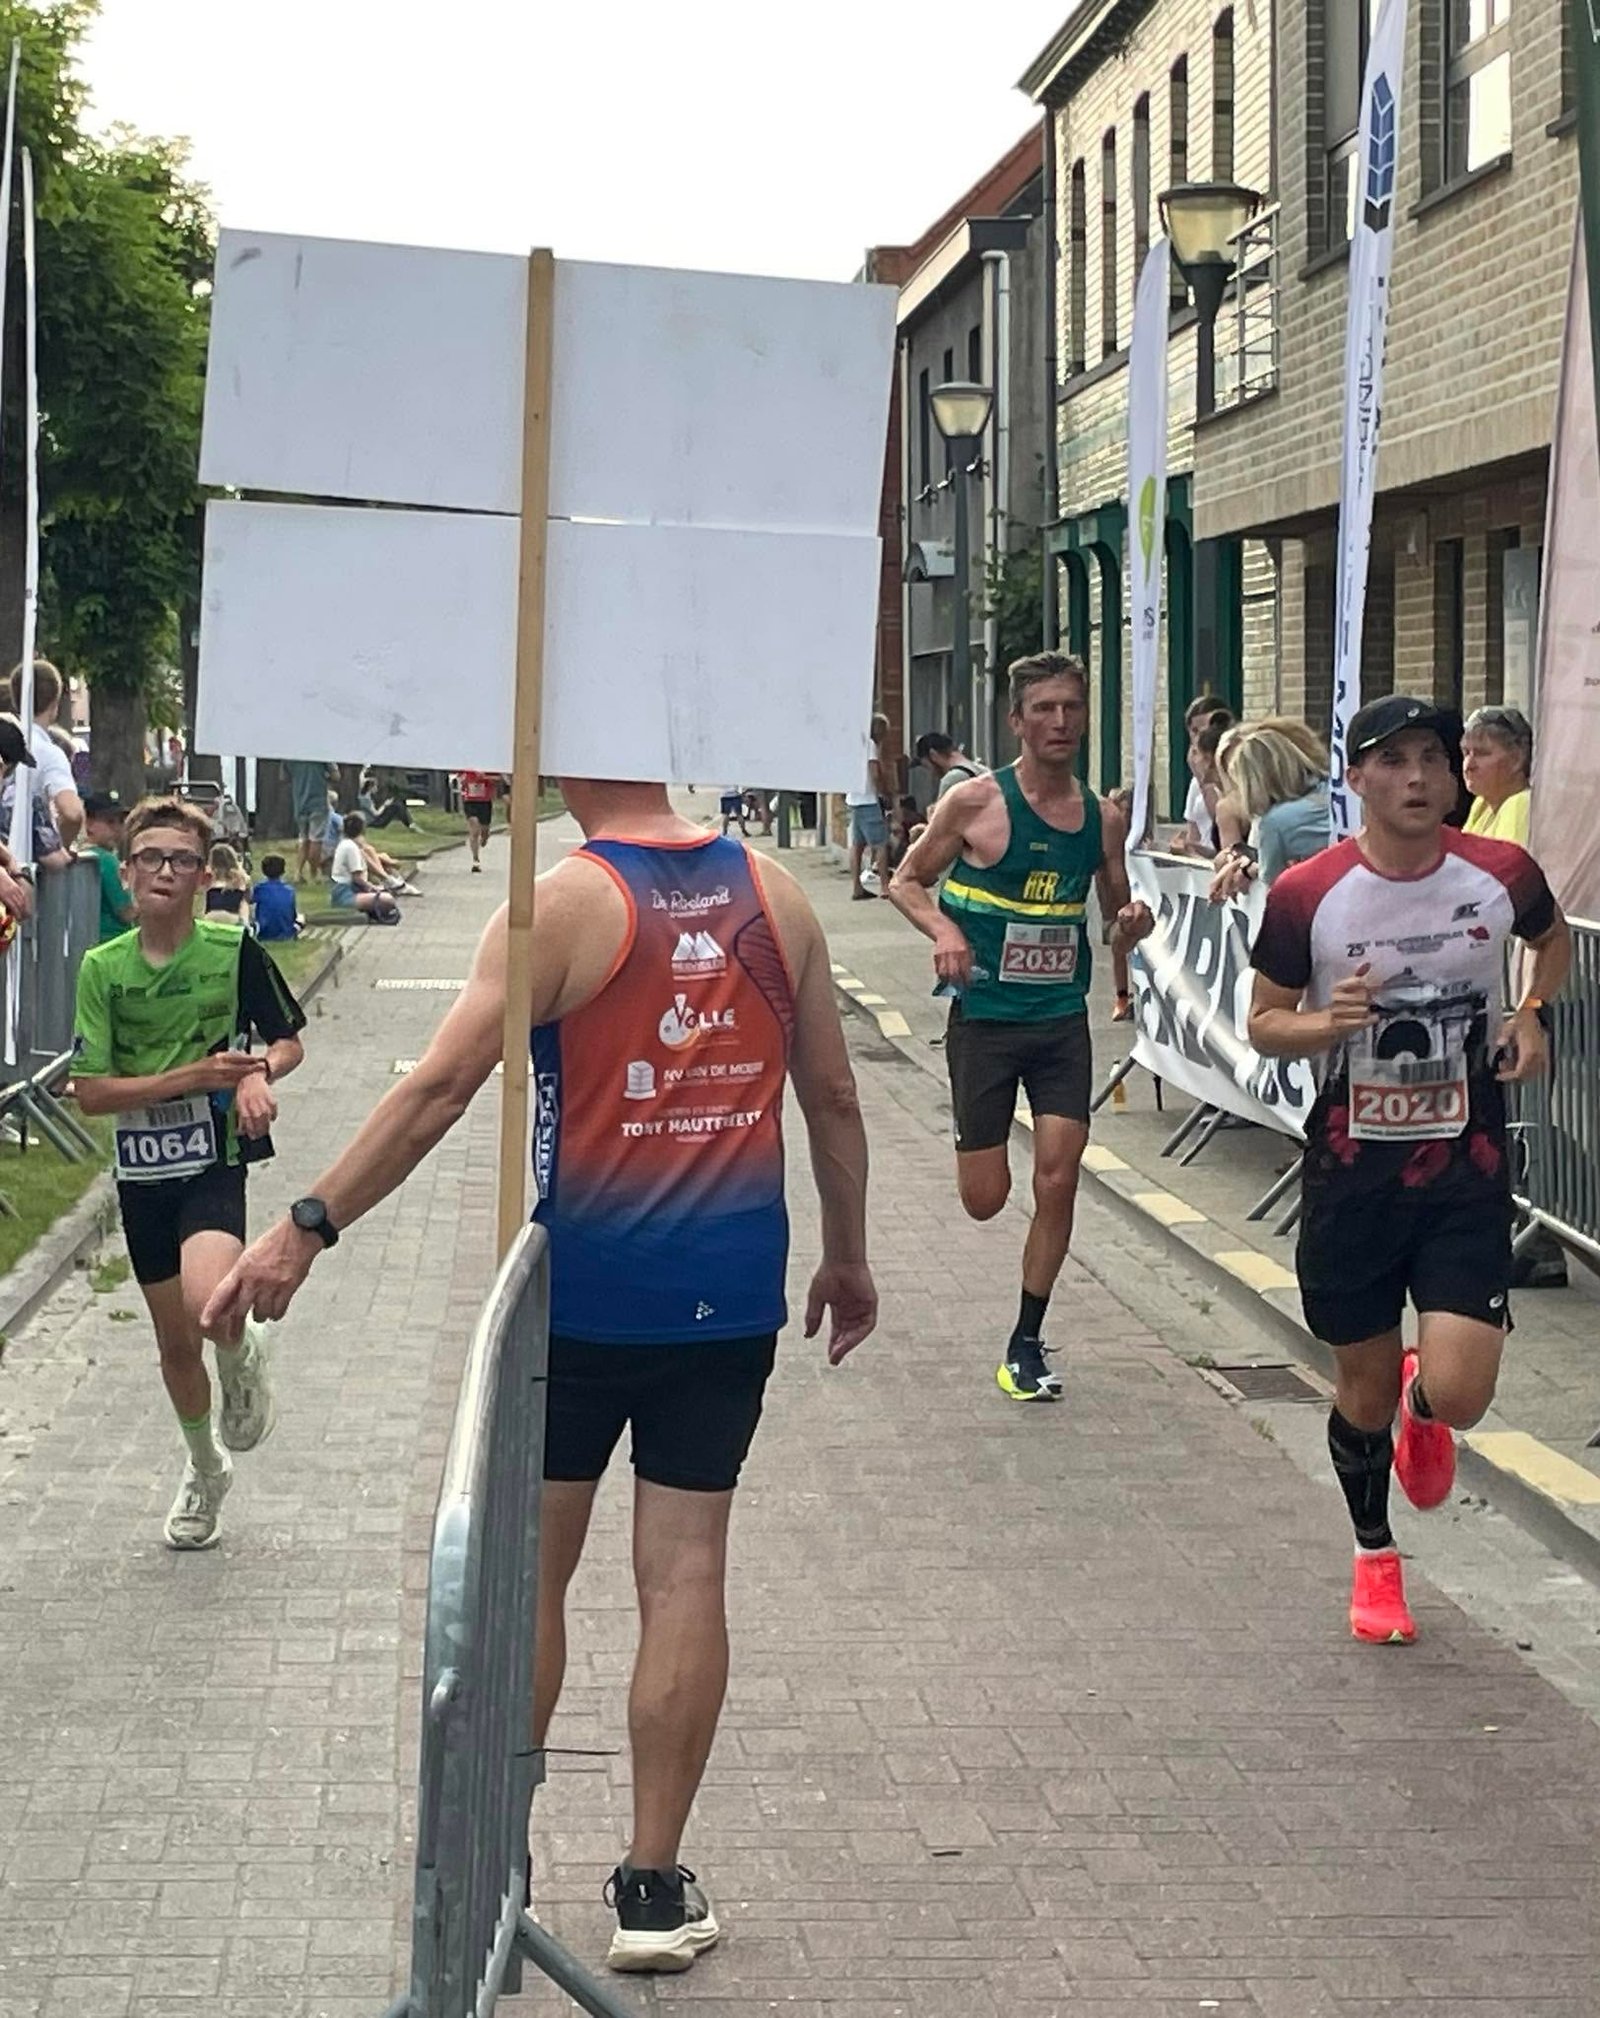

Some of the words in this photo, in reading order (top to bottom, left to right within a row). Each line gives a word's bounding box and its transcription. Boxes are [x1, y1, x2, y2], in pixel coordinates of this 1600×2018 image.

[1007, 947, 1073, 971] 2032
[1357, 1087, 1461, 1122] 2020
[121, 1127, 209, 1164] 1064
